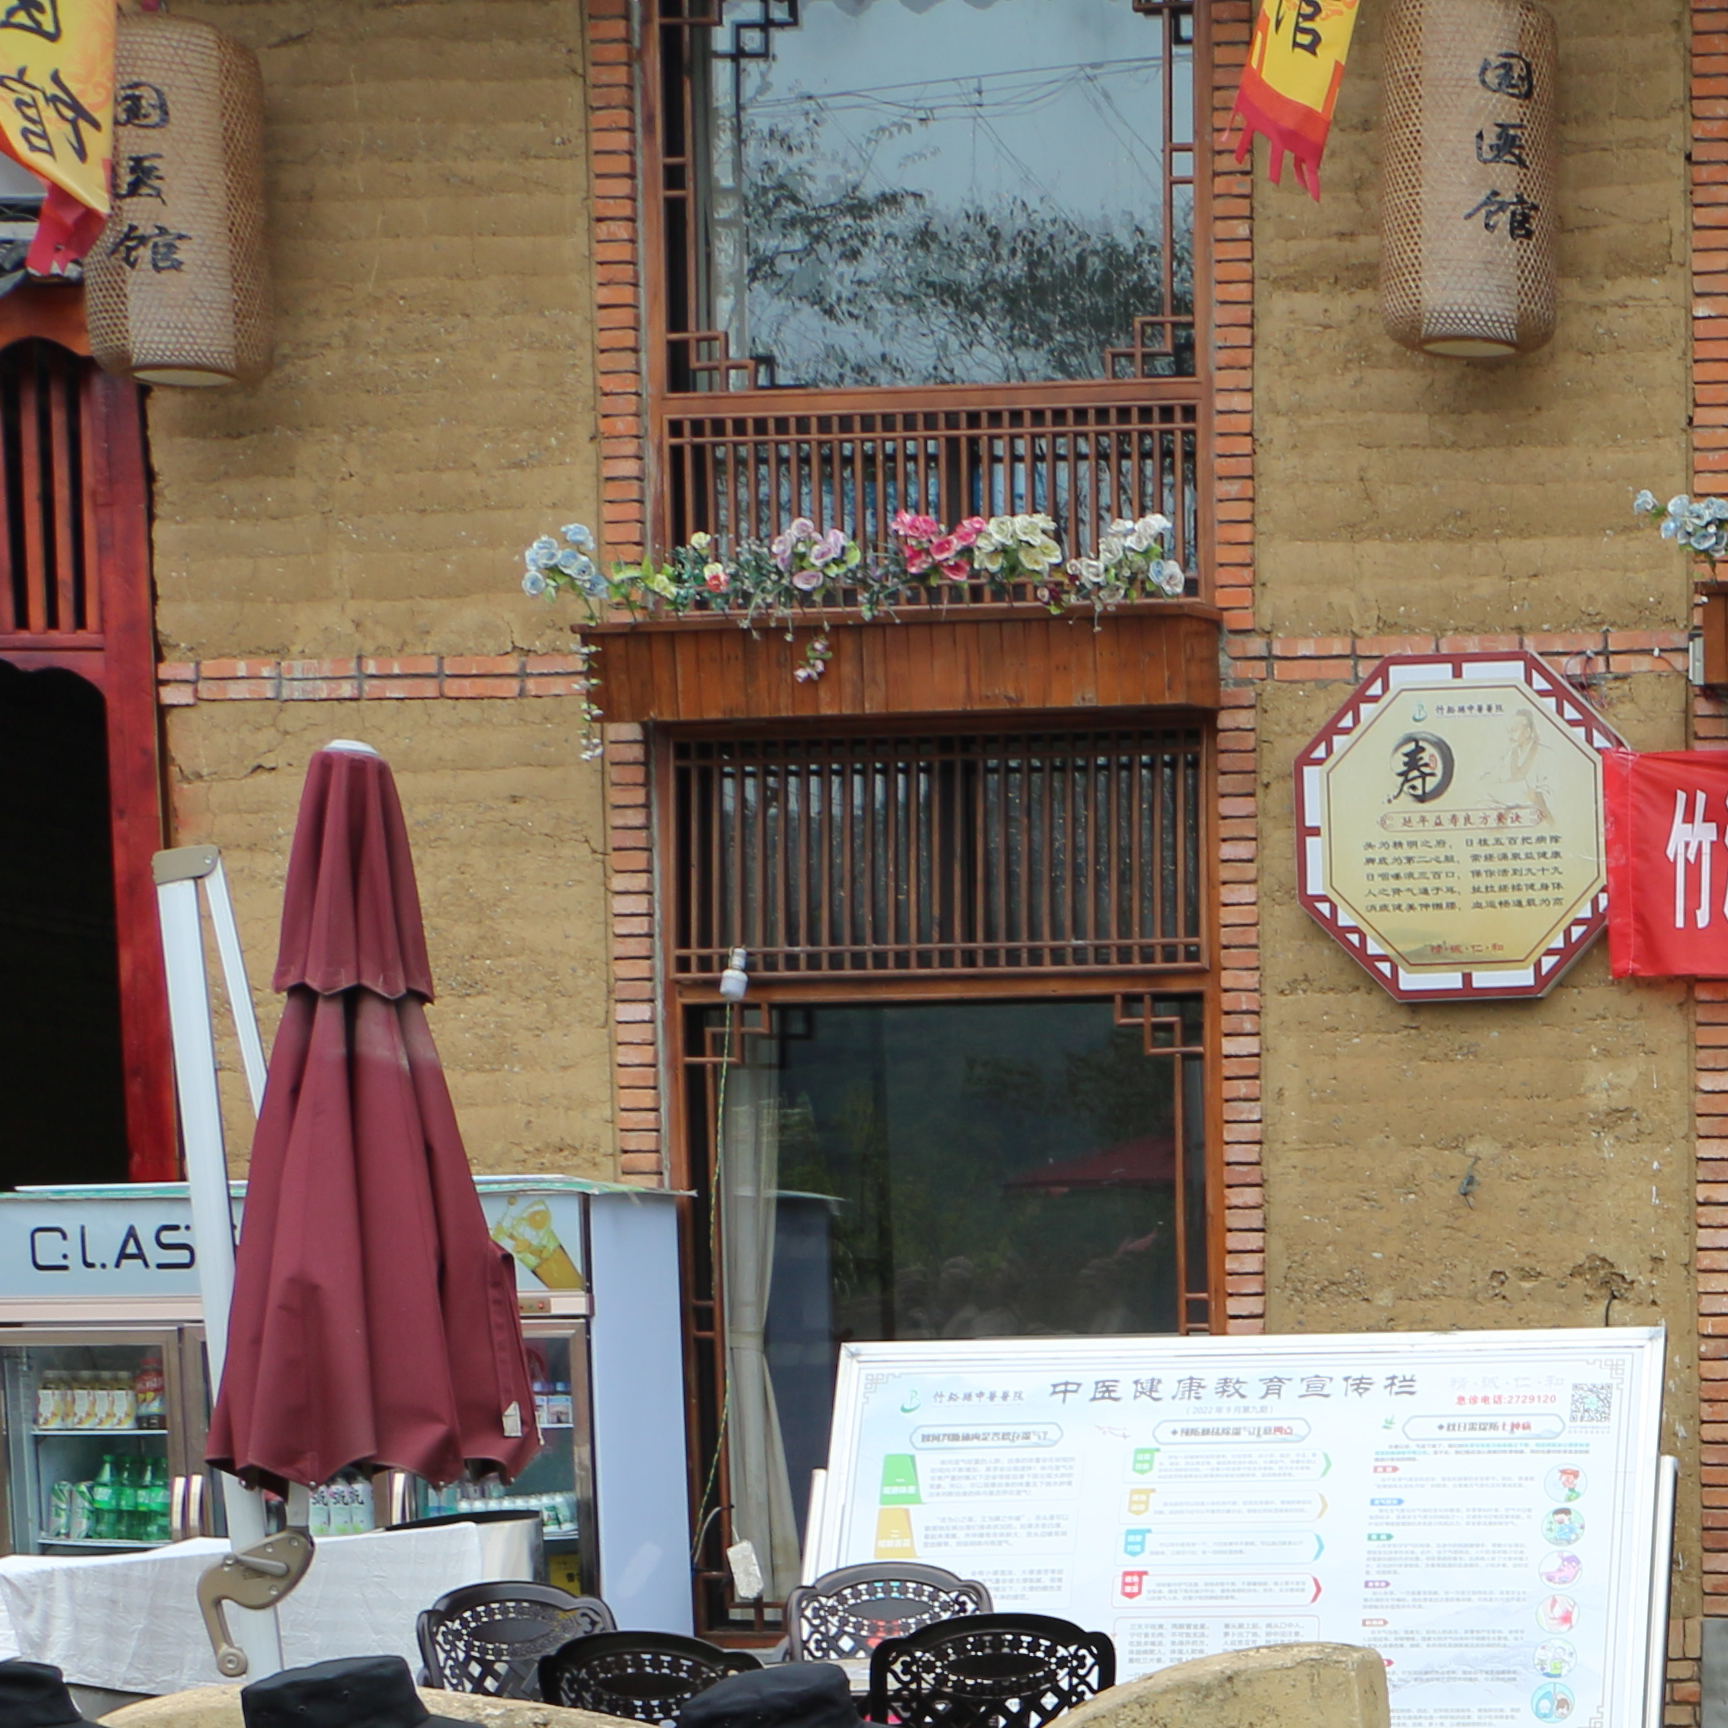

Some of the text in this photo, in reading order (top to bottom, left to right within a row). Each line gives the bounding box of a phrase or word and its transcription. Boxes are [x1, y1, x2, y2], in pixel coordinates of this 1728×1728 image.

[1463, 52, 1539, 241] 国医馆
[1049, 1374, 1418, 1405] 中医健康教育宣传栏
